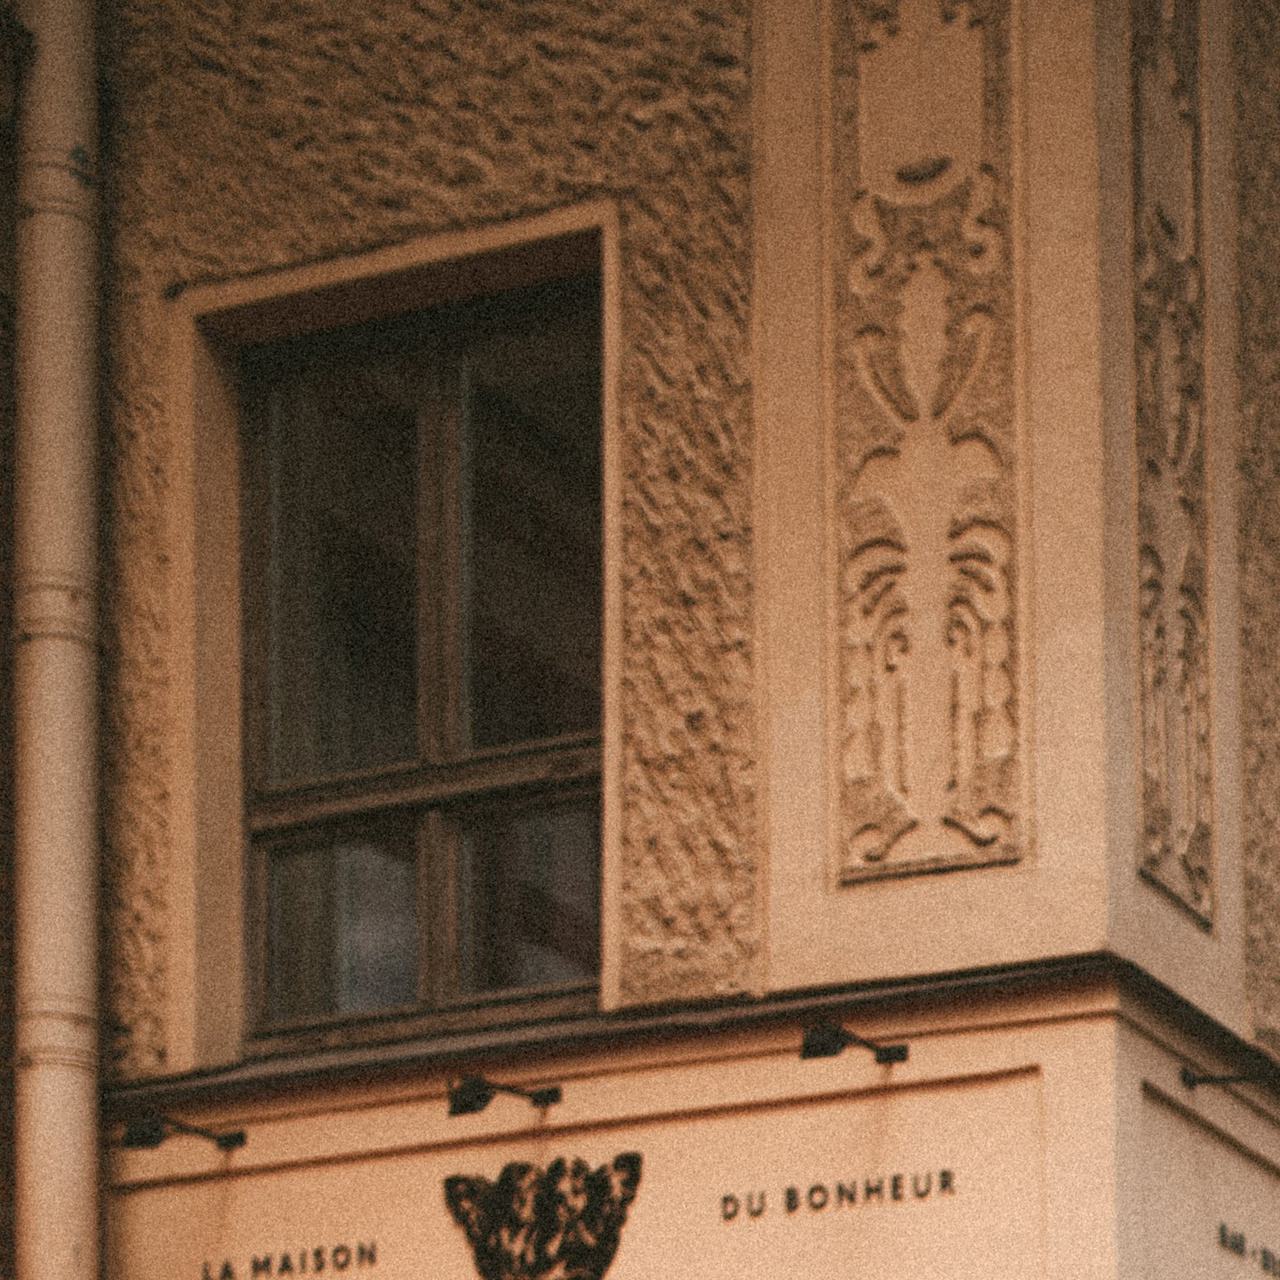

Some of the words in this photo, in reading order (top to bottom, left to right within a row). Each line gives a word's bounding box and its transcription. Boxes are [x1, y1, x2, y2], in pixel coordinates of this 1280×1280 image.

[251, 1240, 378, 1280] MAISON
[720, 1191, 766, 1221] DU
[784, 1168, 955, 1214] BONHEUR
